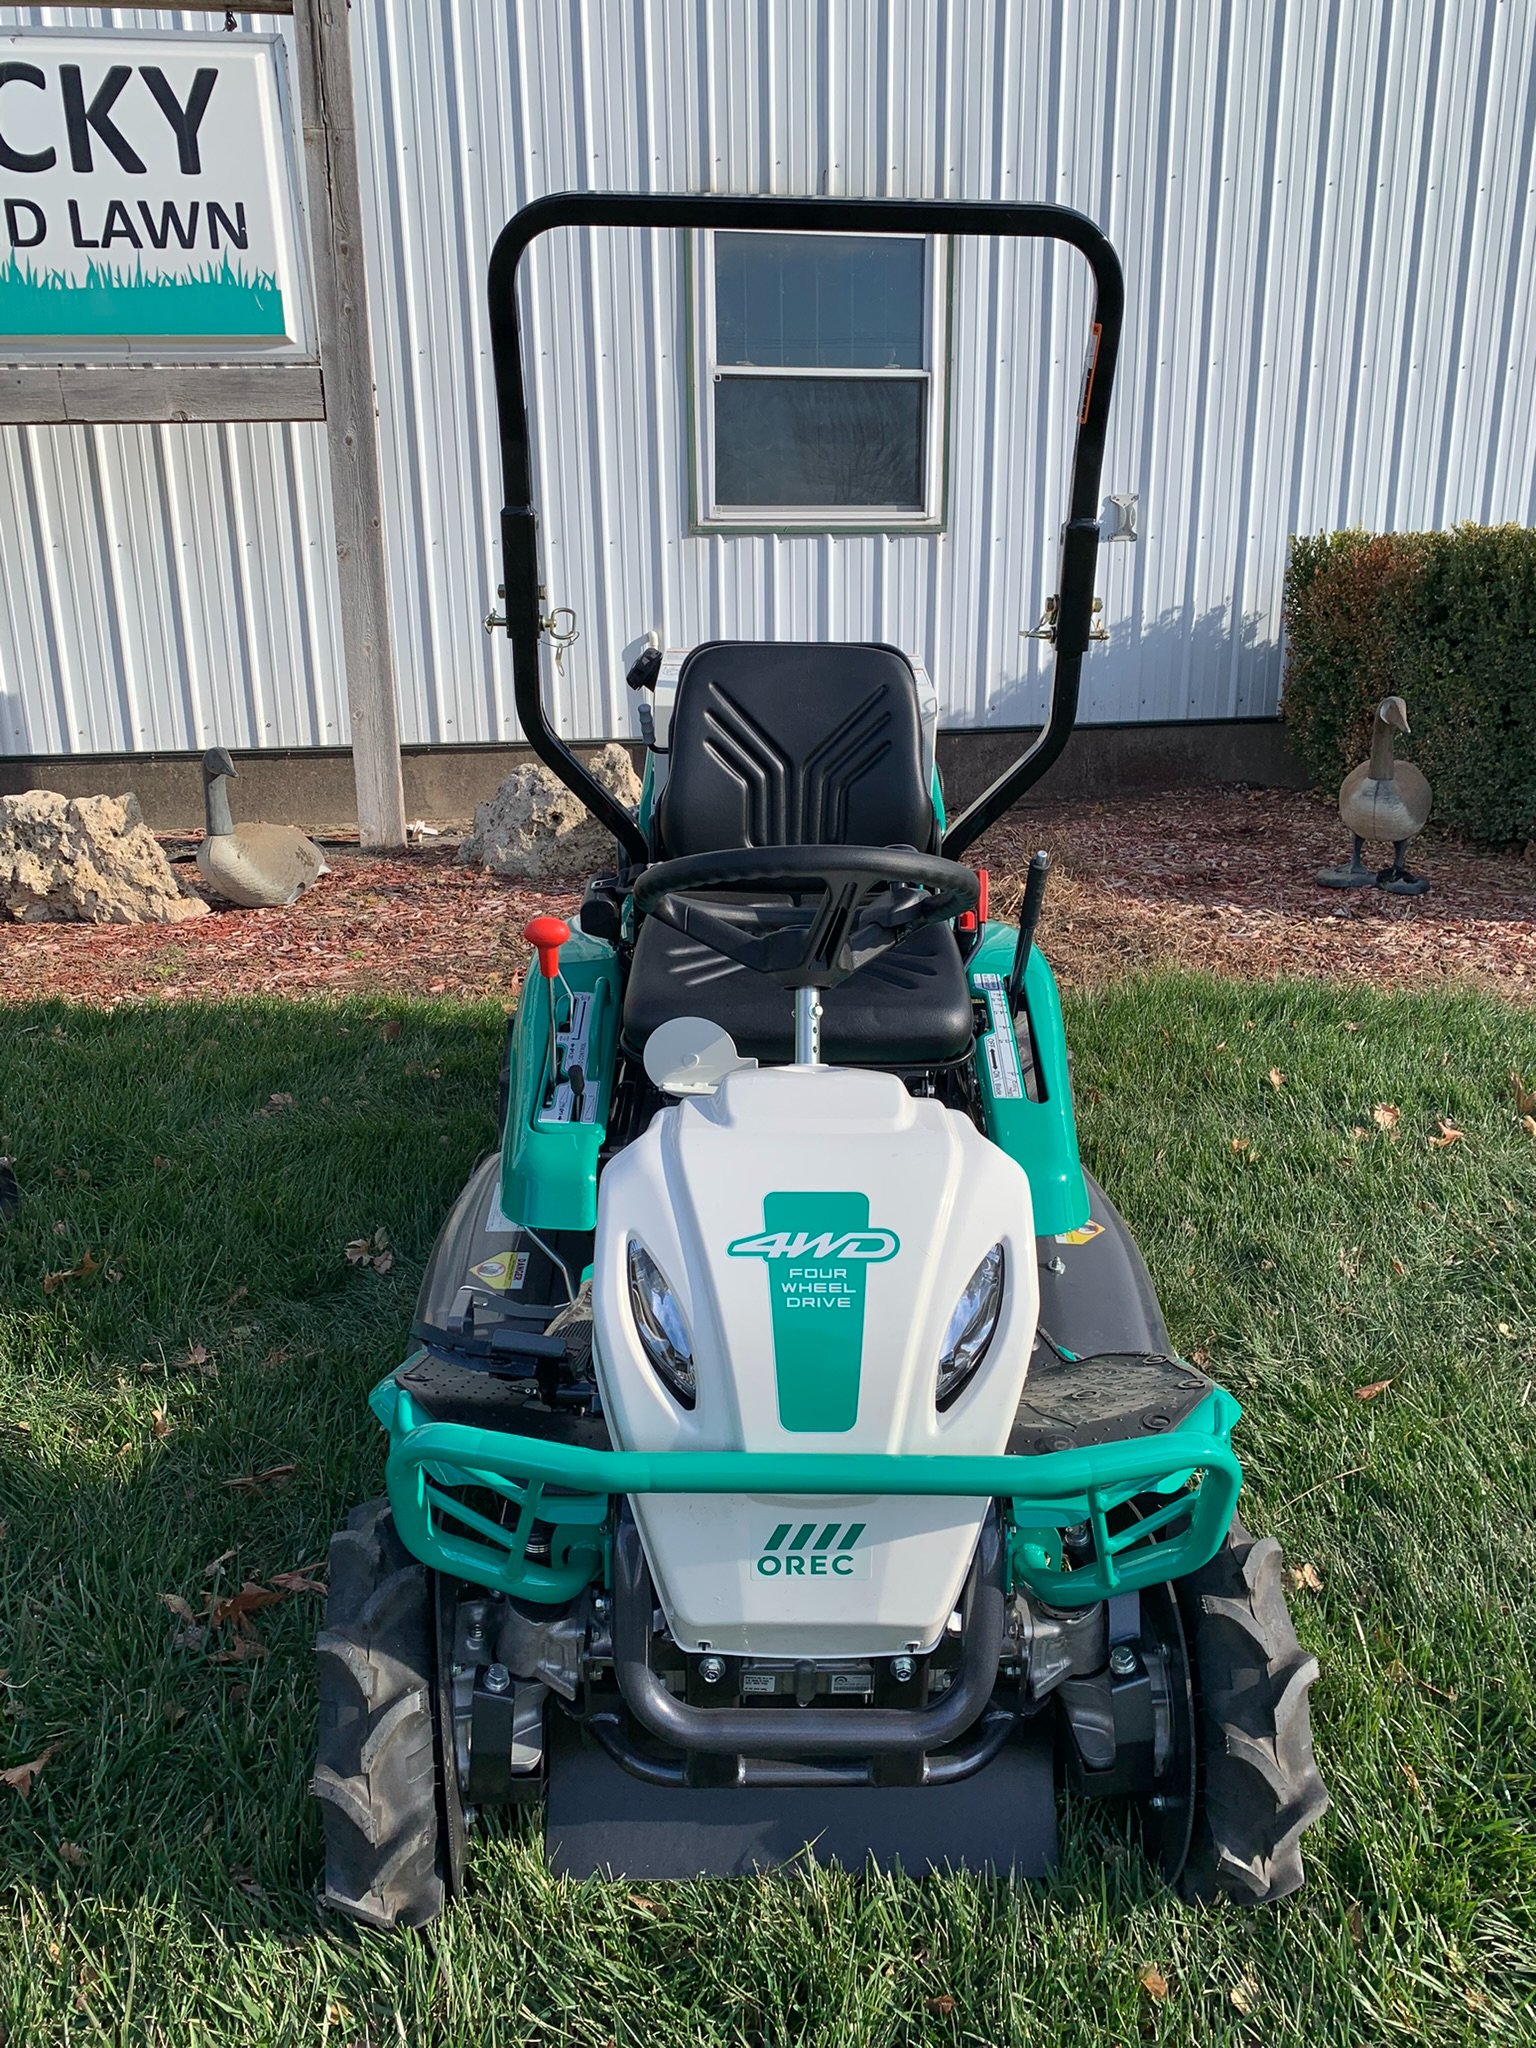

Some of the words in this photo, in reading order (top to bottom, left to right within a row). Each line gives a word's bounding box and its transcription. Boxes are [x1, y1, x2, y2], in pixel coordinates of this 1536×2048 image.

[68, 199, 249, 250] LAWN
[732, 1232, 896, 1259] 4WD
[789, 1268, 847, 1279] FOUR
[781, 1282, 857, 1294] WHEEL
[786, 1297, 851, 1308] DRIVE
[757, 1554, 854, 1576] OREC
